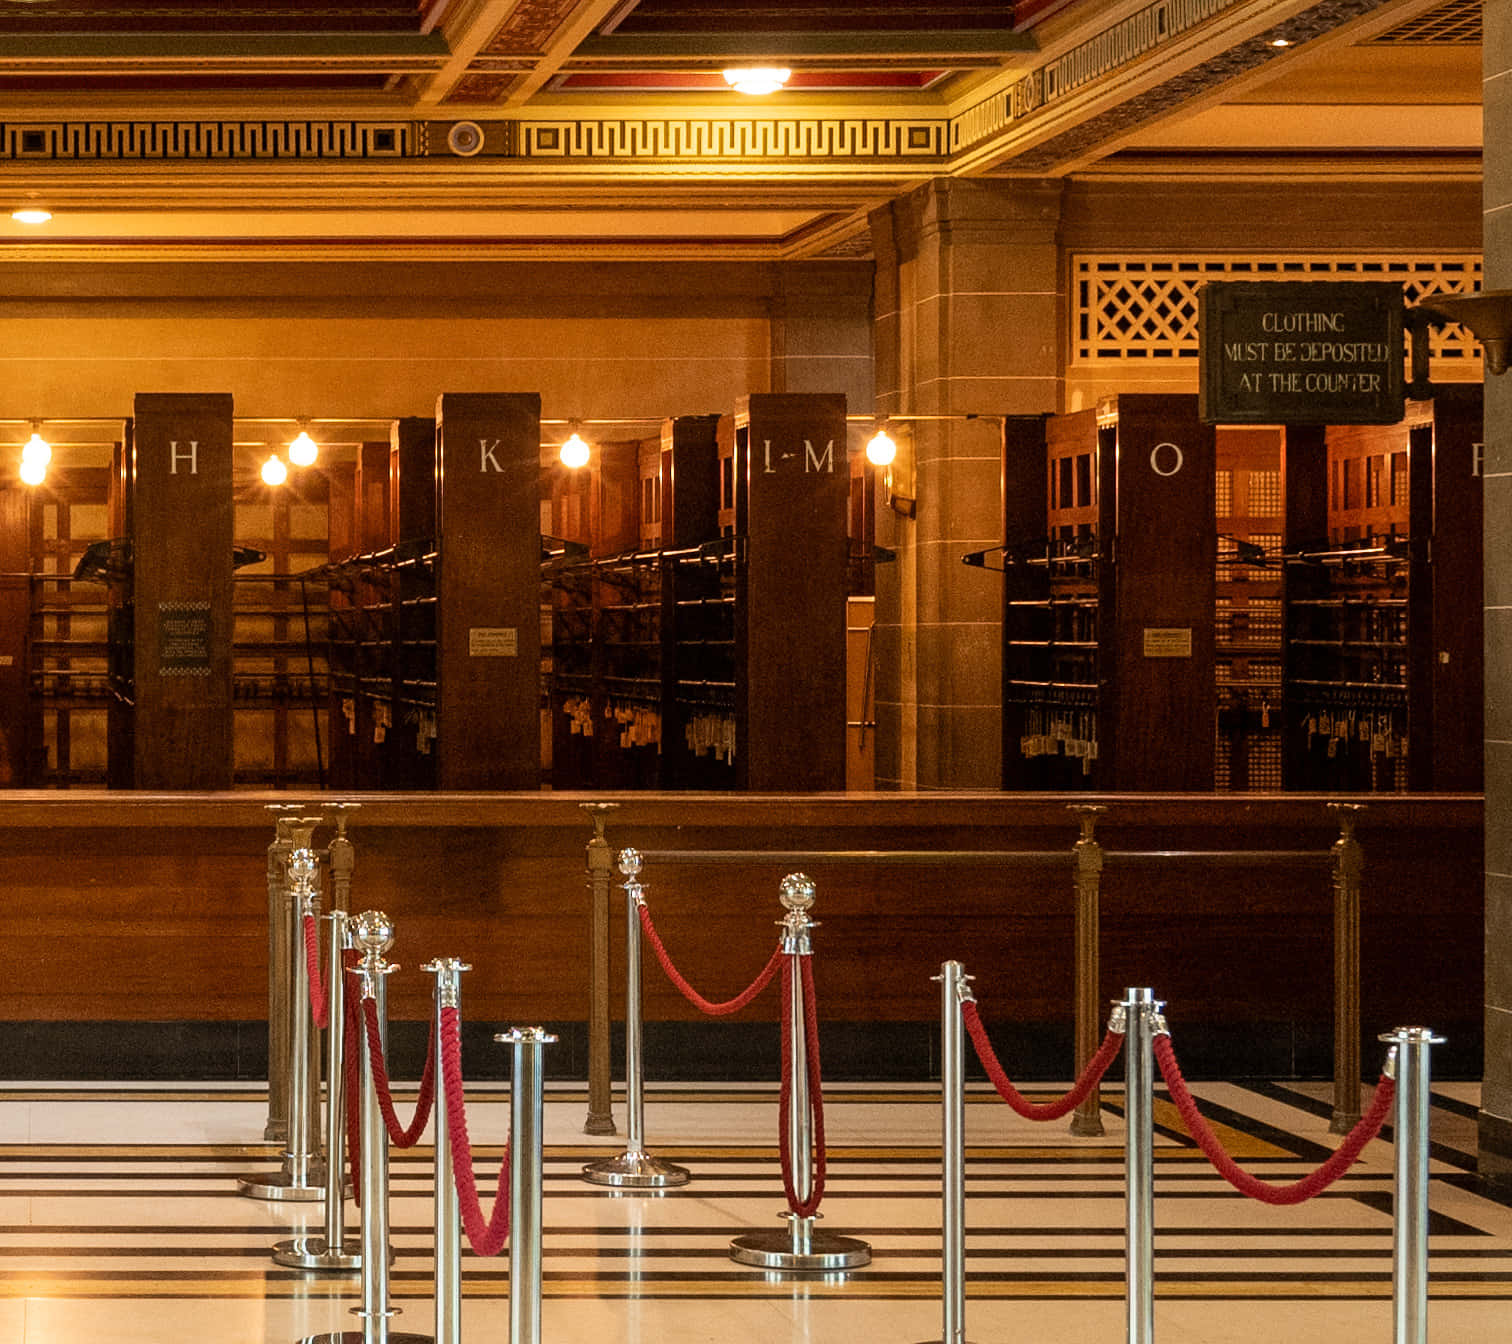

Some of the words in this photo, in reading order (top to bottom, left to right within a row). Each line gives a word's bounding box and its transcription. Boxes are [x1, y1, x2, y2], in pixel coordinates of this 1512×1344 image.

[1262, 312, 1345, 333] CLOTHING
[1224, 342, 1269, 361] MUST
[1274, 342, 1296, 362] BE
[1300, 342, 1389, 362] DEPOSITED
[1239, 373, 1263, 393] AT
[1268, 373, 1302, 393] THE
[1305, 373, 1381, 393] COUNTER
[169, 440, 199, 474] H
[479, 439, 505, 473] K
[1150, 442, 1184, 477] O
